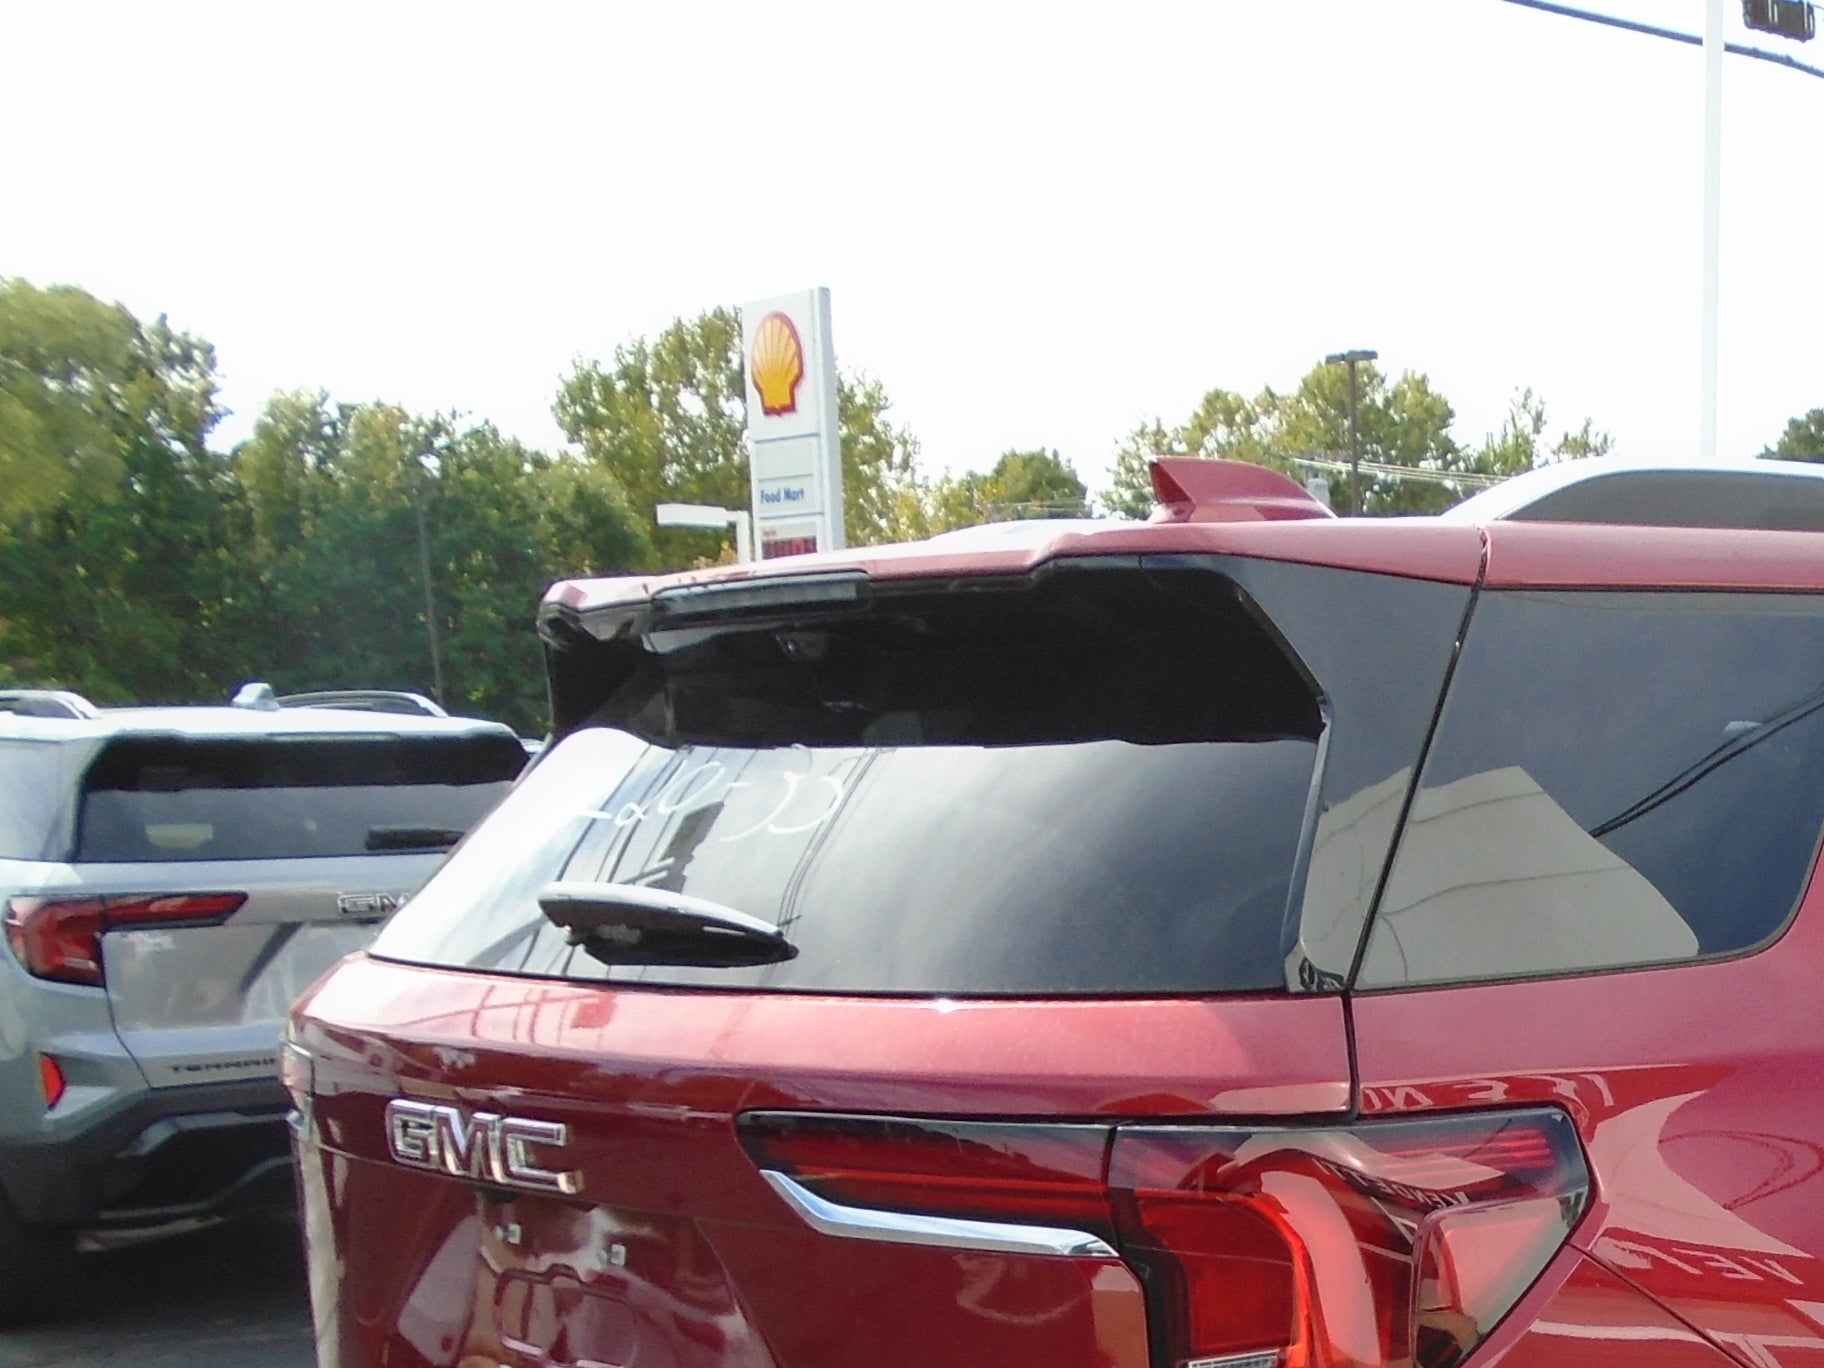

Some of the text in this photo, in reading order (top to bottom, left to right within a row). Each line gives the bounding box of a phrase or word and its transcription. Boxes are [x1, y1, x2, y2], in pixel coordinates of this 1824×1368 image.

[760, 487, 804, 504] Food Mart
[337, 893, 409, 914] GM
[384, 1098, 586, 1195] GMC
